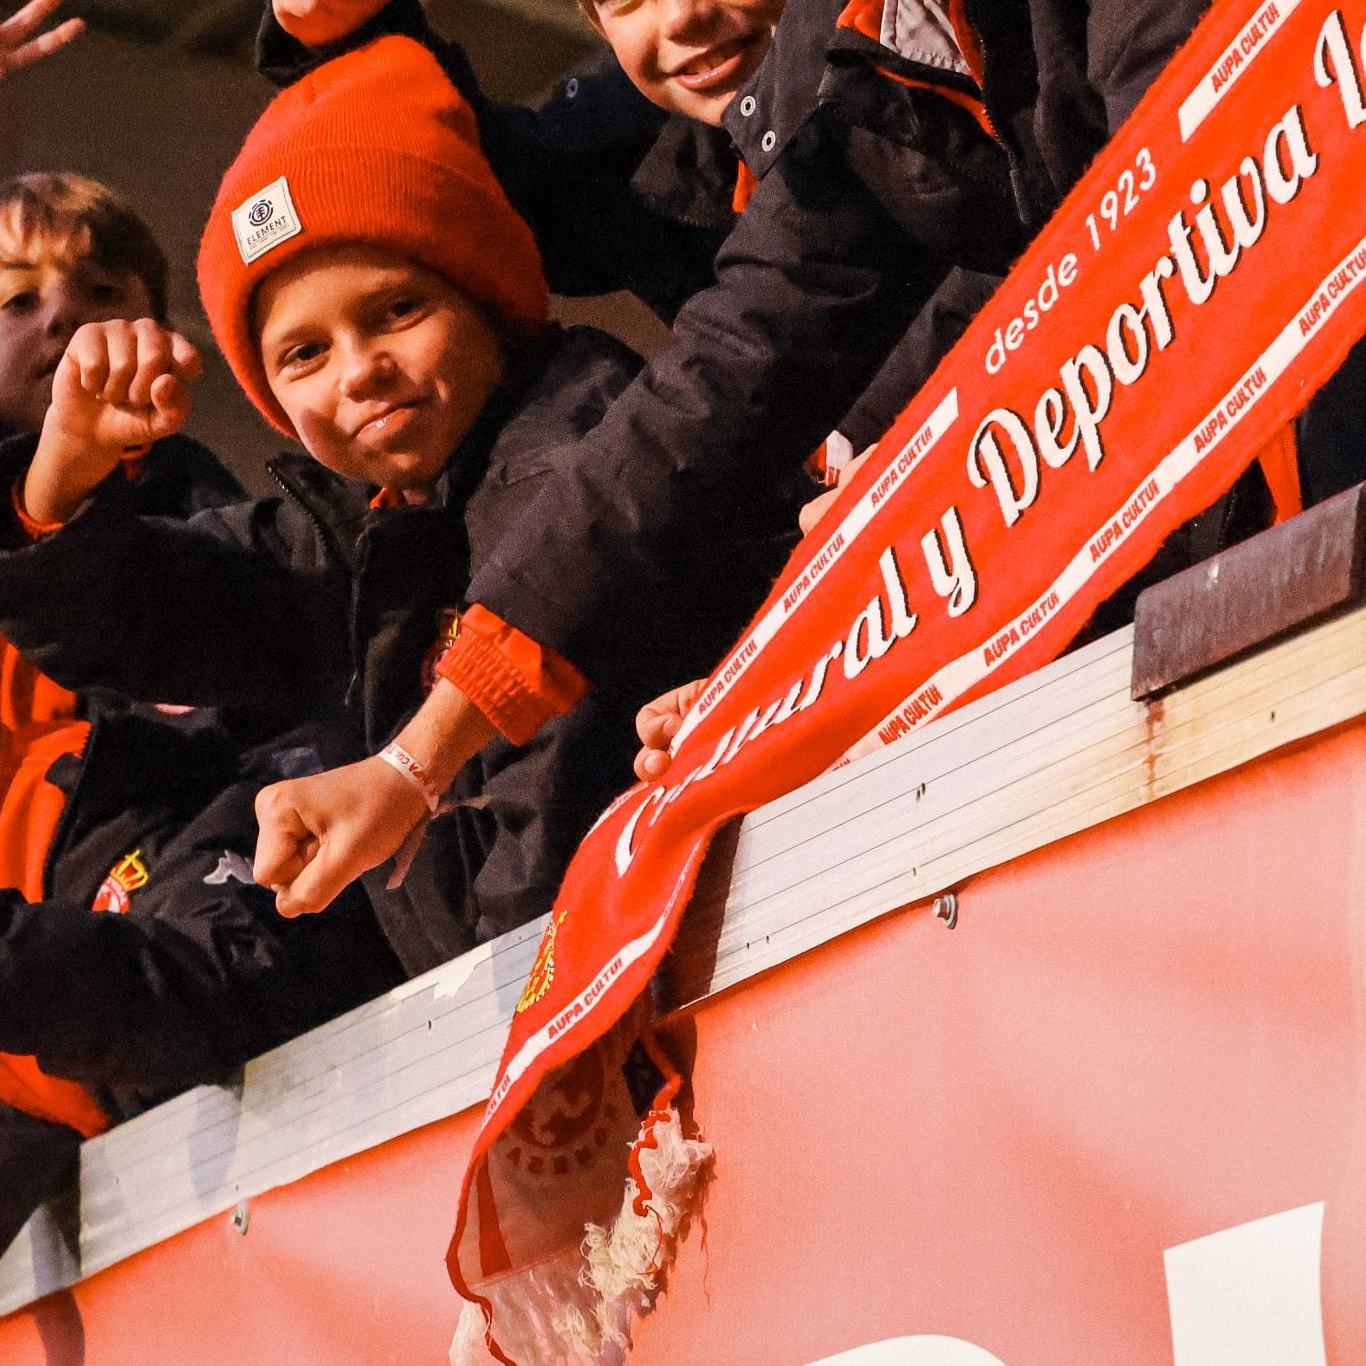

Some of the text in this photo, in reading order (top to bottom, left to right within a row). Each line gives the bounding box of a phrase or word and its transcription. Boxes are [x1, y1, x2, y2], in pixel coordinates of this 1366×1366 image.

[1211, 47, 1244, 94] AUPA
[246, 214, 287, 245] ELEMENT
[984, 146, 1158, 375] desde 1923
[1298, 291, 1331, 338] AUPA
[920, 505, 979, 618] y
[966, 104, 1321, 529] Deportiva
[1193, 409, 1229, 454] AUPA
[870, 467, 899, 508] AUPA
[1089, 519, 1124, 563] AUPA
[783, 574, 811, 614] AUPA
[983, 626, 1021, 668] AUPA
[698, 680, 725, 715] AUPA
[547, 1002, 584, 1040] AUPA
